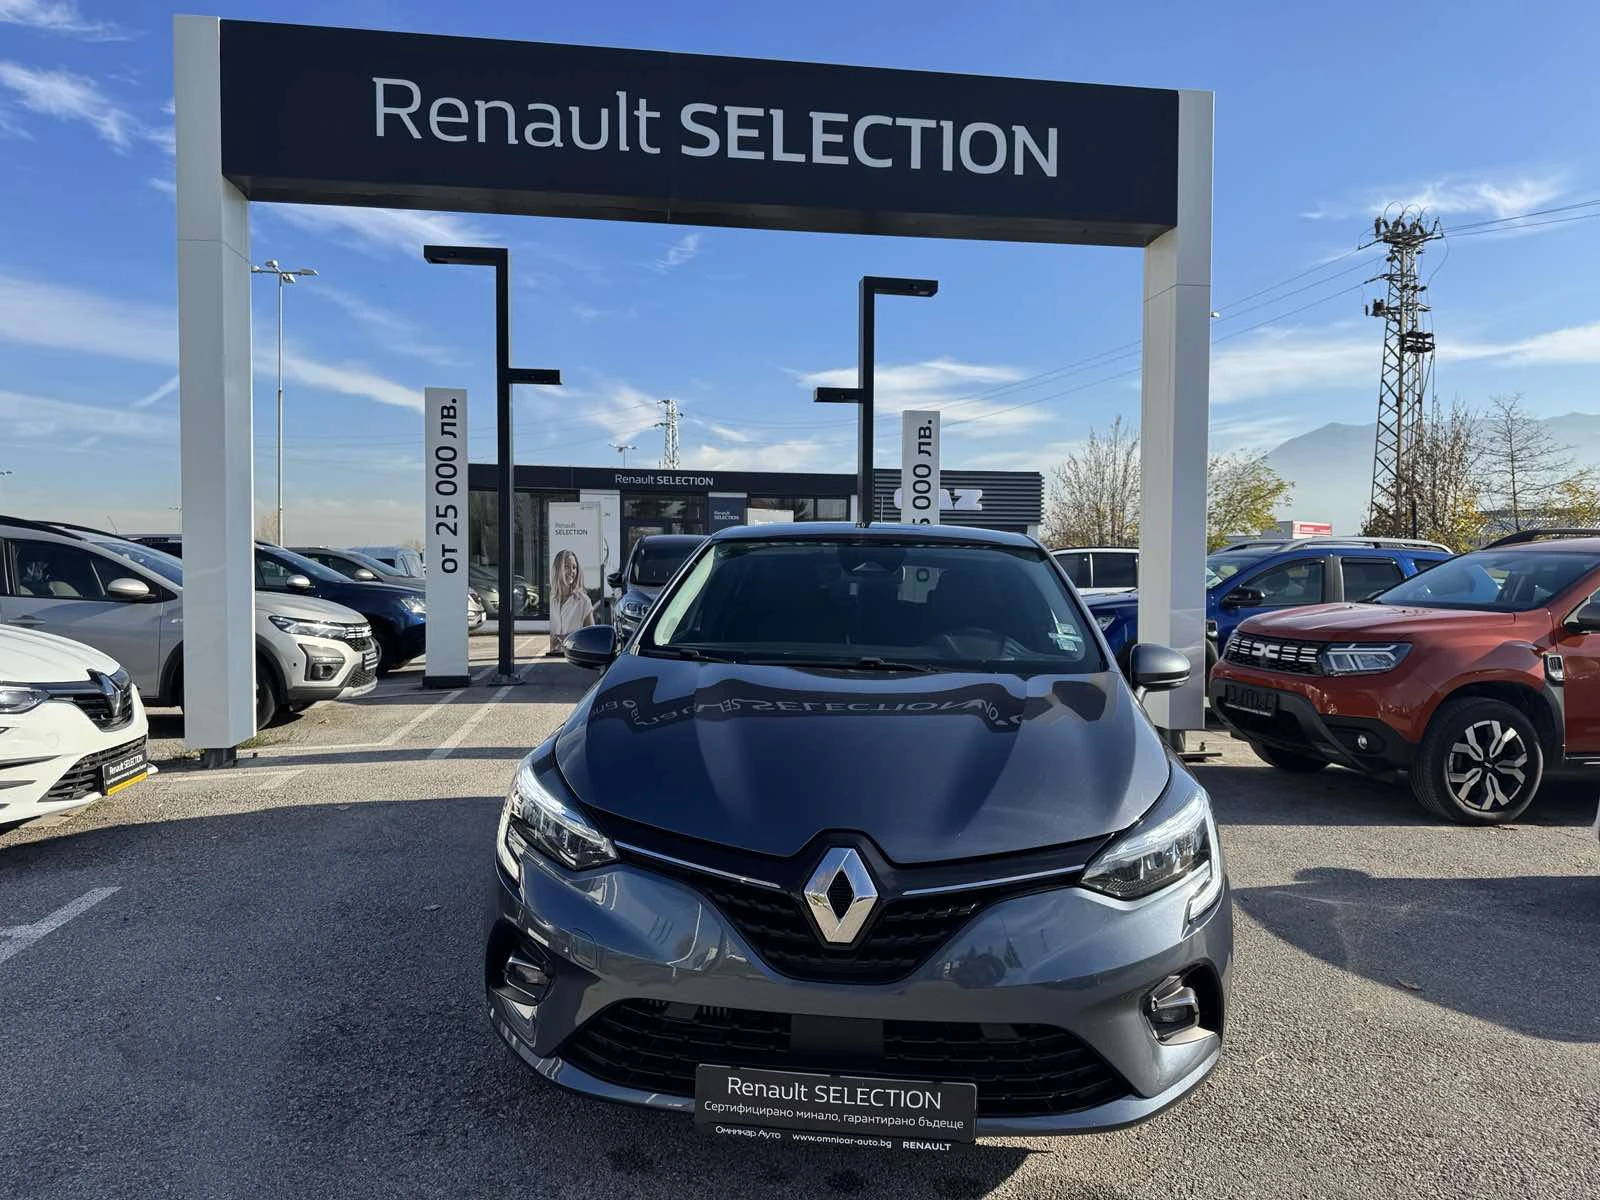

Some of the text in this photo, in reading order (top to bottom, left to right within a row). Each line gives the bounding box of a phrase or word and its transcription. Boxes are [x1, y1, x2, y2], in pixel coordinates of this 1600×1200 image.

[372, 77, 1058, 177] Renault SELECTION
[918, 419, 933, 457] лв.
[435, 398, 458, 574] от 25 000 лв.
[615, 474, 714, 486] Renault SELECTION
[912, 463, 932, 510] 000
[728, 1077, 941, 1110] Renault SELECTION
[704, 1101, 964, 1130] Сертифицирано минало, гарантирано бъдеще
[902, 1141, 952, 1151] RENAULT
